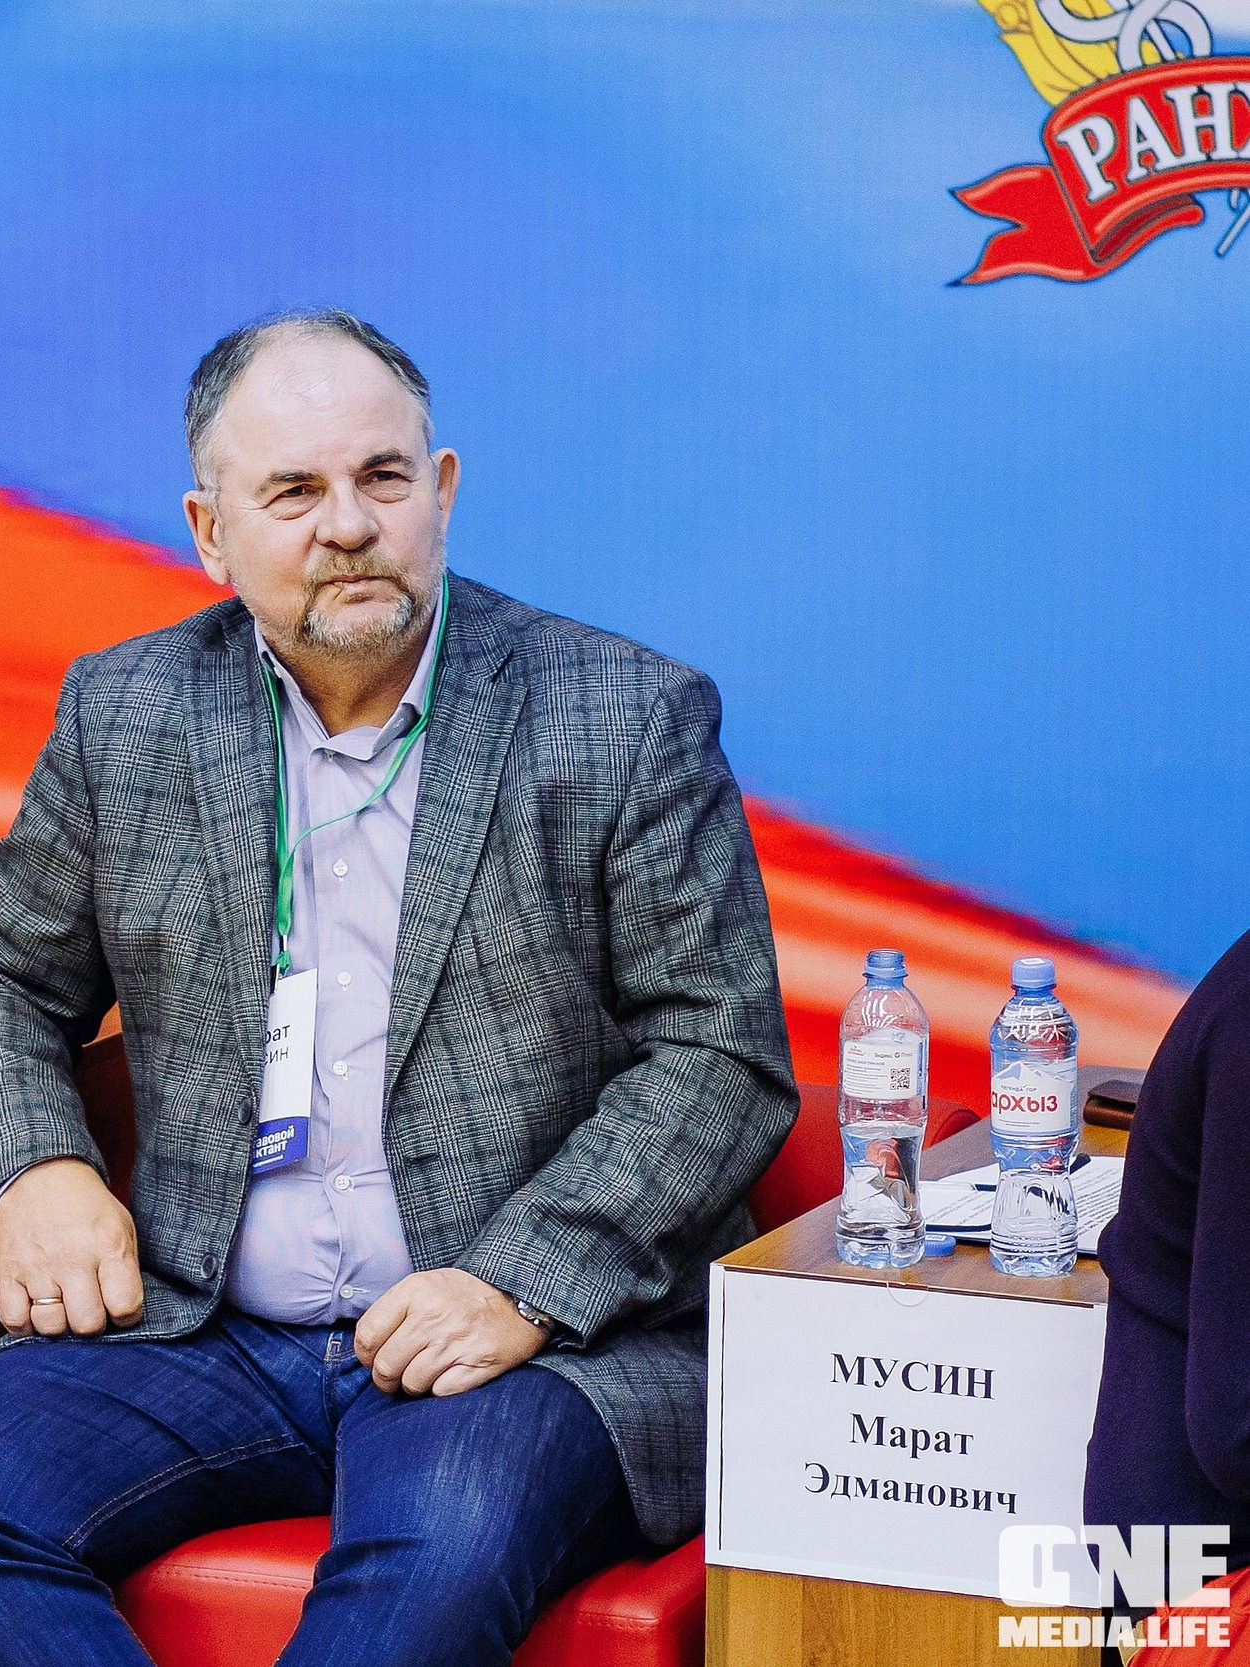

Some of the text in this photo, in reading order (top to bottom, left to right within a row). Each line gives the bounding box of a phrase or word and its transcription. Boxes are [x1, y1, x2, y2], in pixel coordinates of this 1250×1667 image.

[829, 1352, 996, 1400] МУСИН
[848, 1412, 975, 1459] Марат
[804, 1462, 1018, 1515] Эдманович
